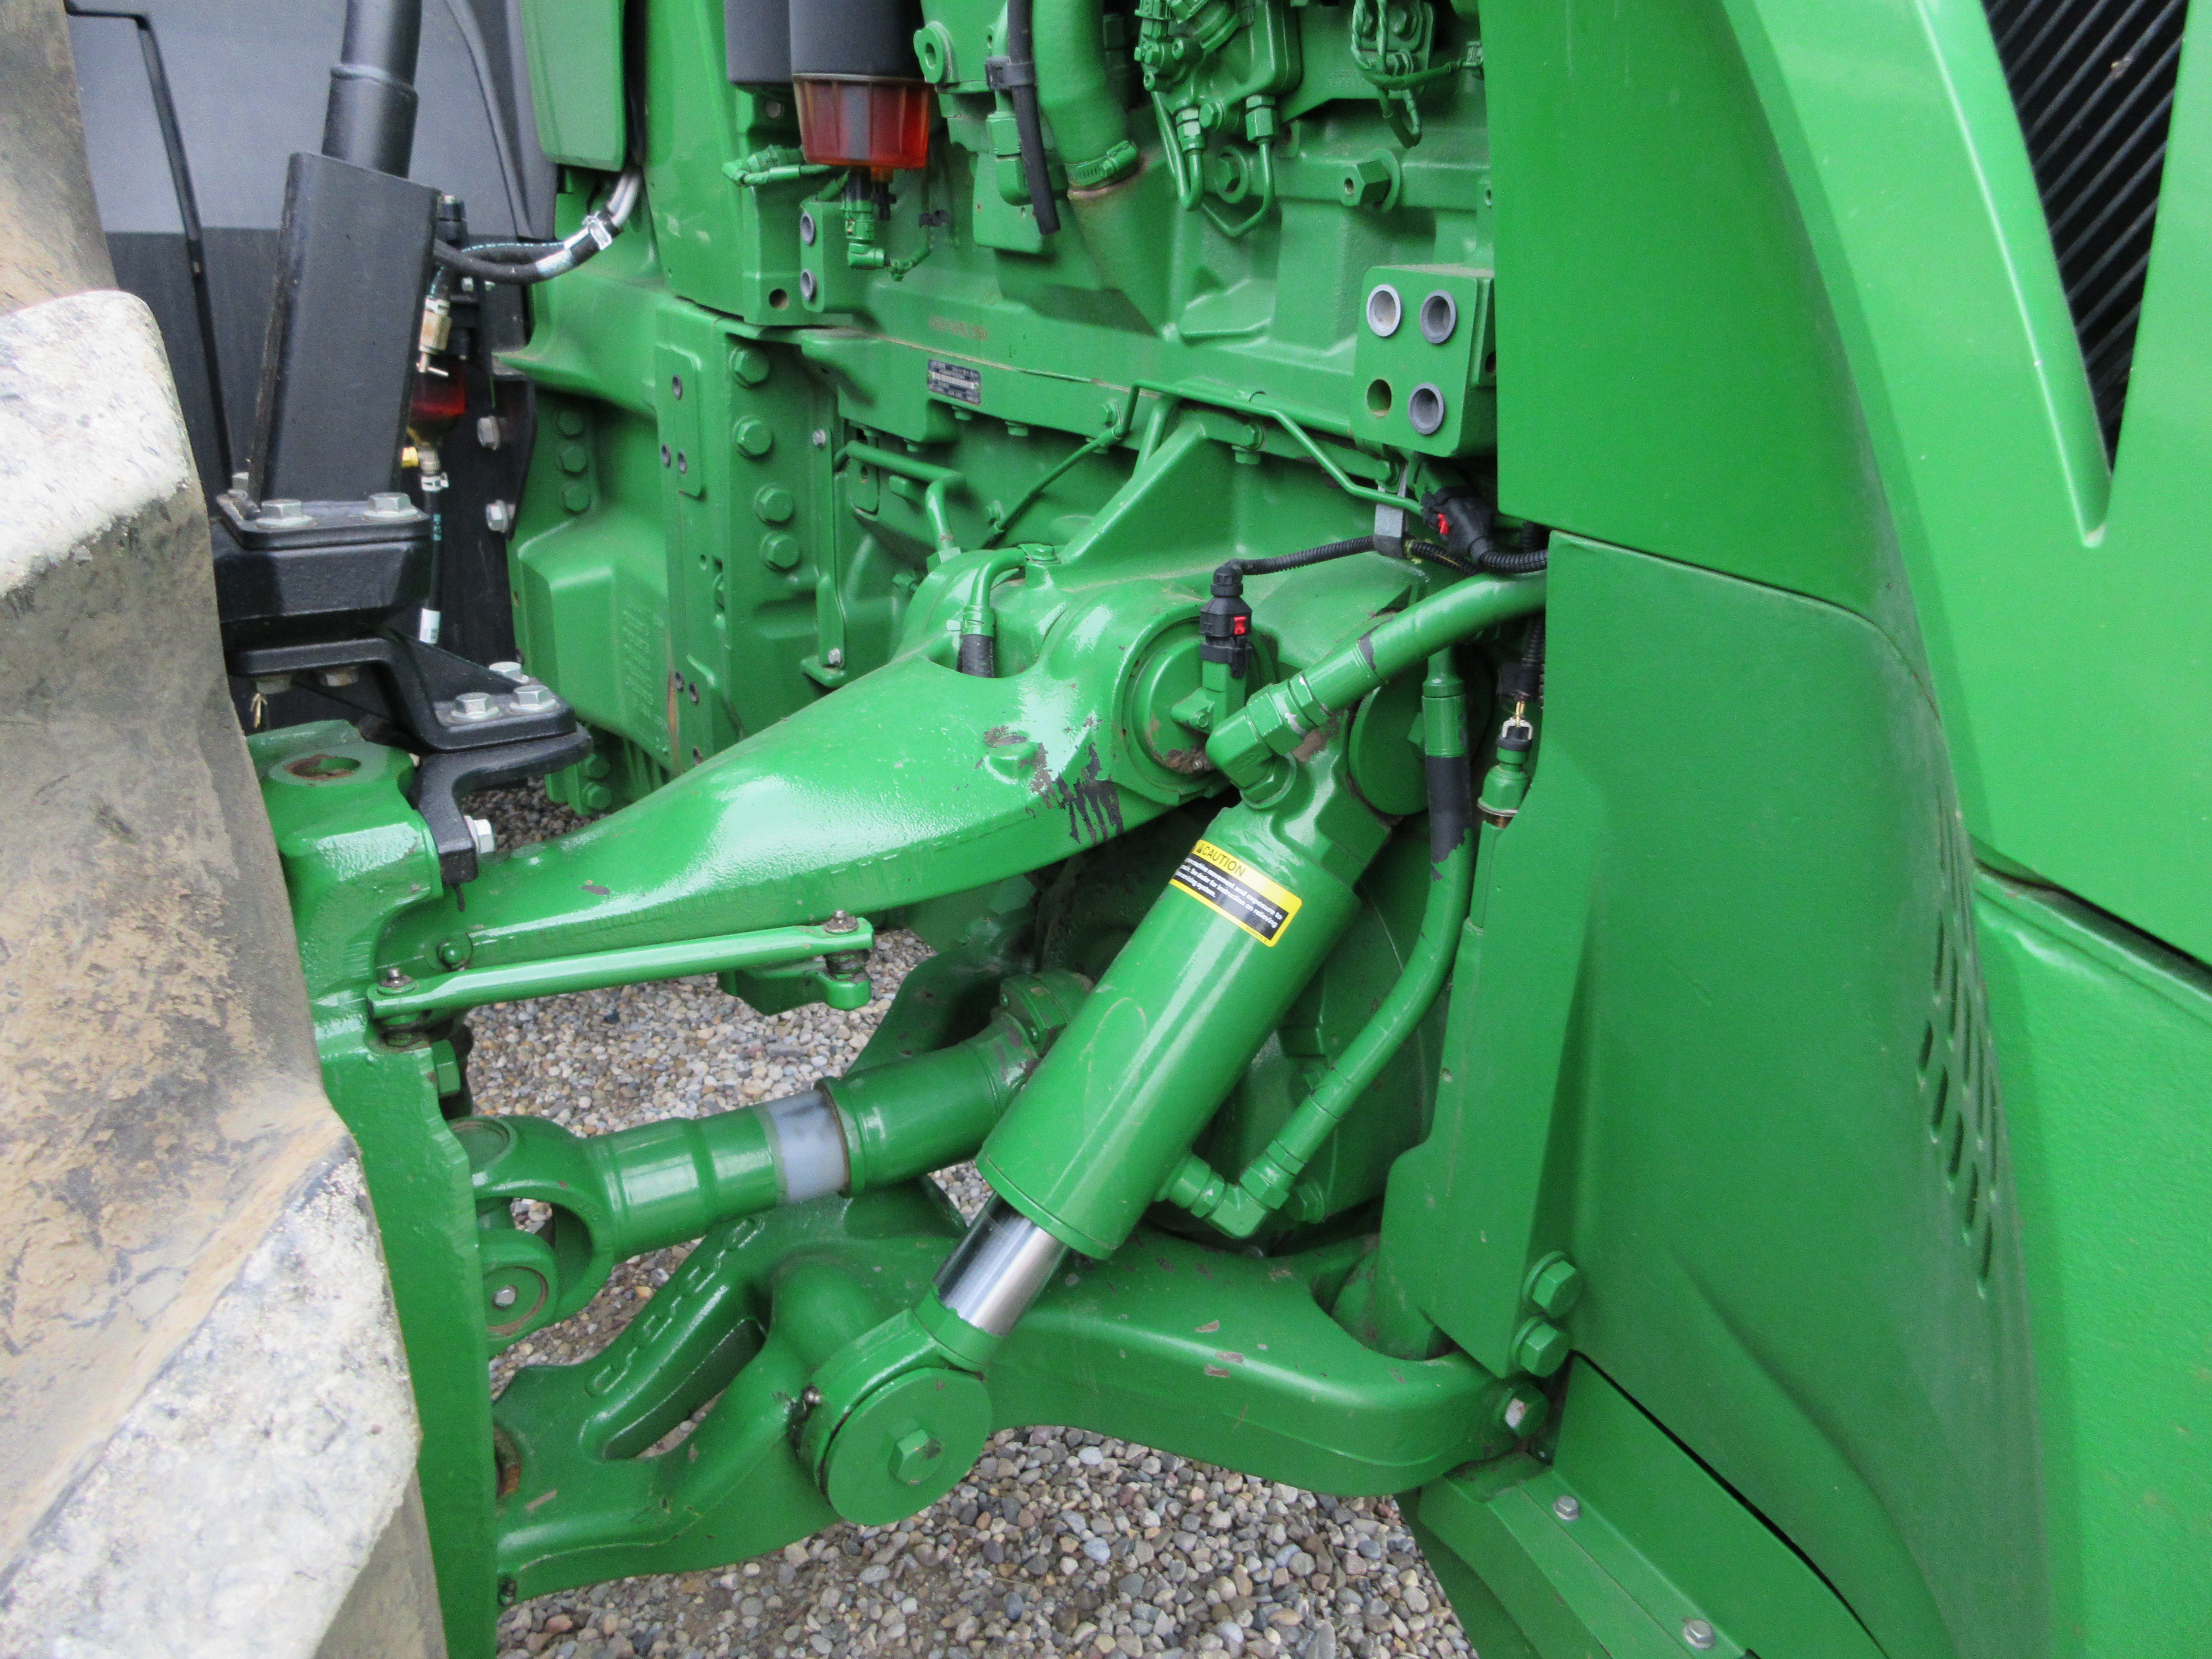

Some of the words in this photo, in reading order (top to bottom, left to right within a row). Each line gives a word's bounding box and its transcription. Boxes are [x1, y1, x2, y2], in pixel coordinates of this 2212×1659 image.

[1202, 846, 1246, 877] CAUTION
[1207, 870, 1235, 889] movement
[1234, 886, 1248, 896] and
[1246, 894, 1275, 915] exposure
[1209, 879, 1218, 888] for
[1217, 884, 1246, 906] instruction
[1253, 909, 1278, 928] relieving
